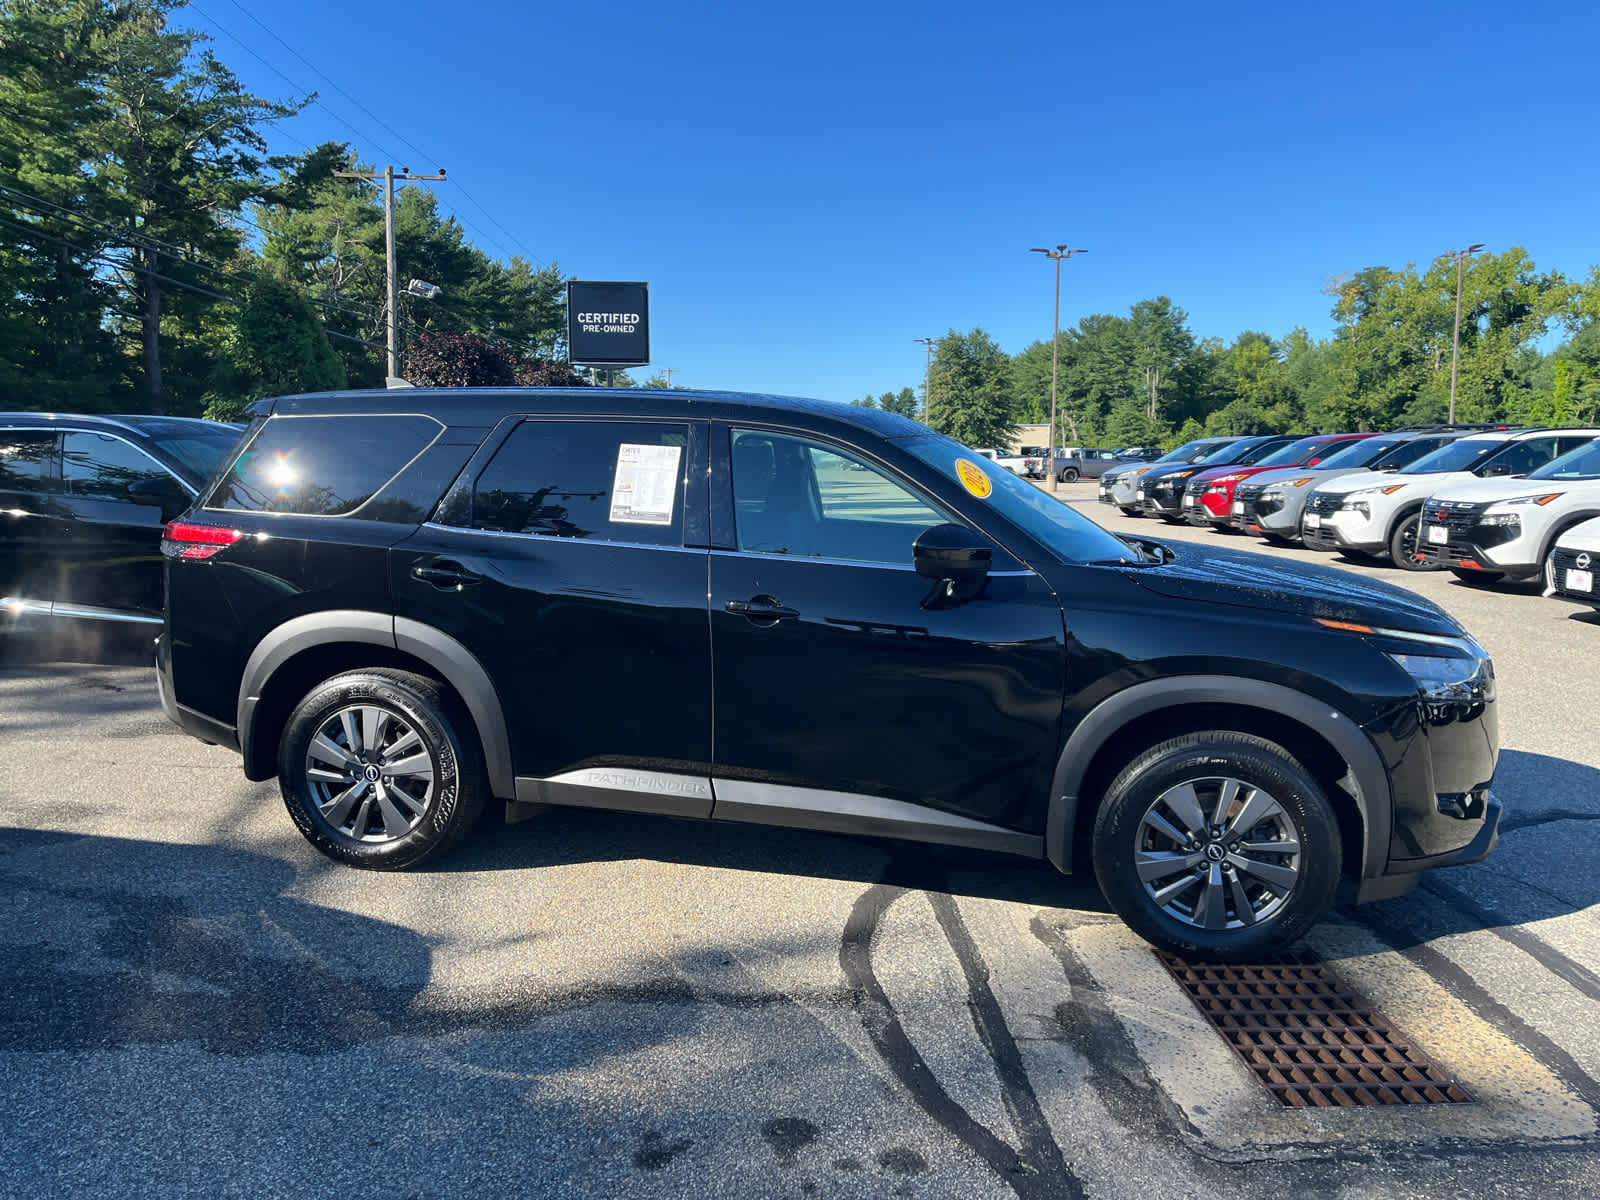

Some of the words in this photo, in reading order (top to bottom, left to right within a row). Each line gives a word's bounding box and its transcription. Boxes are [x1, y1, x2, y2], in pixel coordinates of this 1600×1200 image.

[577, 312, 640, 324] CERTIFIED
[583, 324, 635, 333] PRE-OWNED
[585, 772, 707, 793] PATHFINDER
